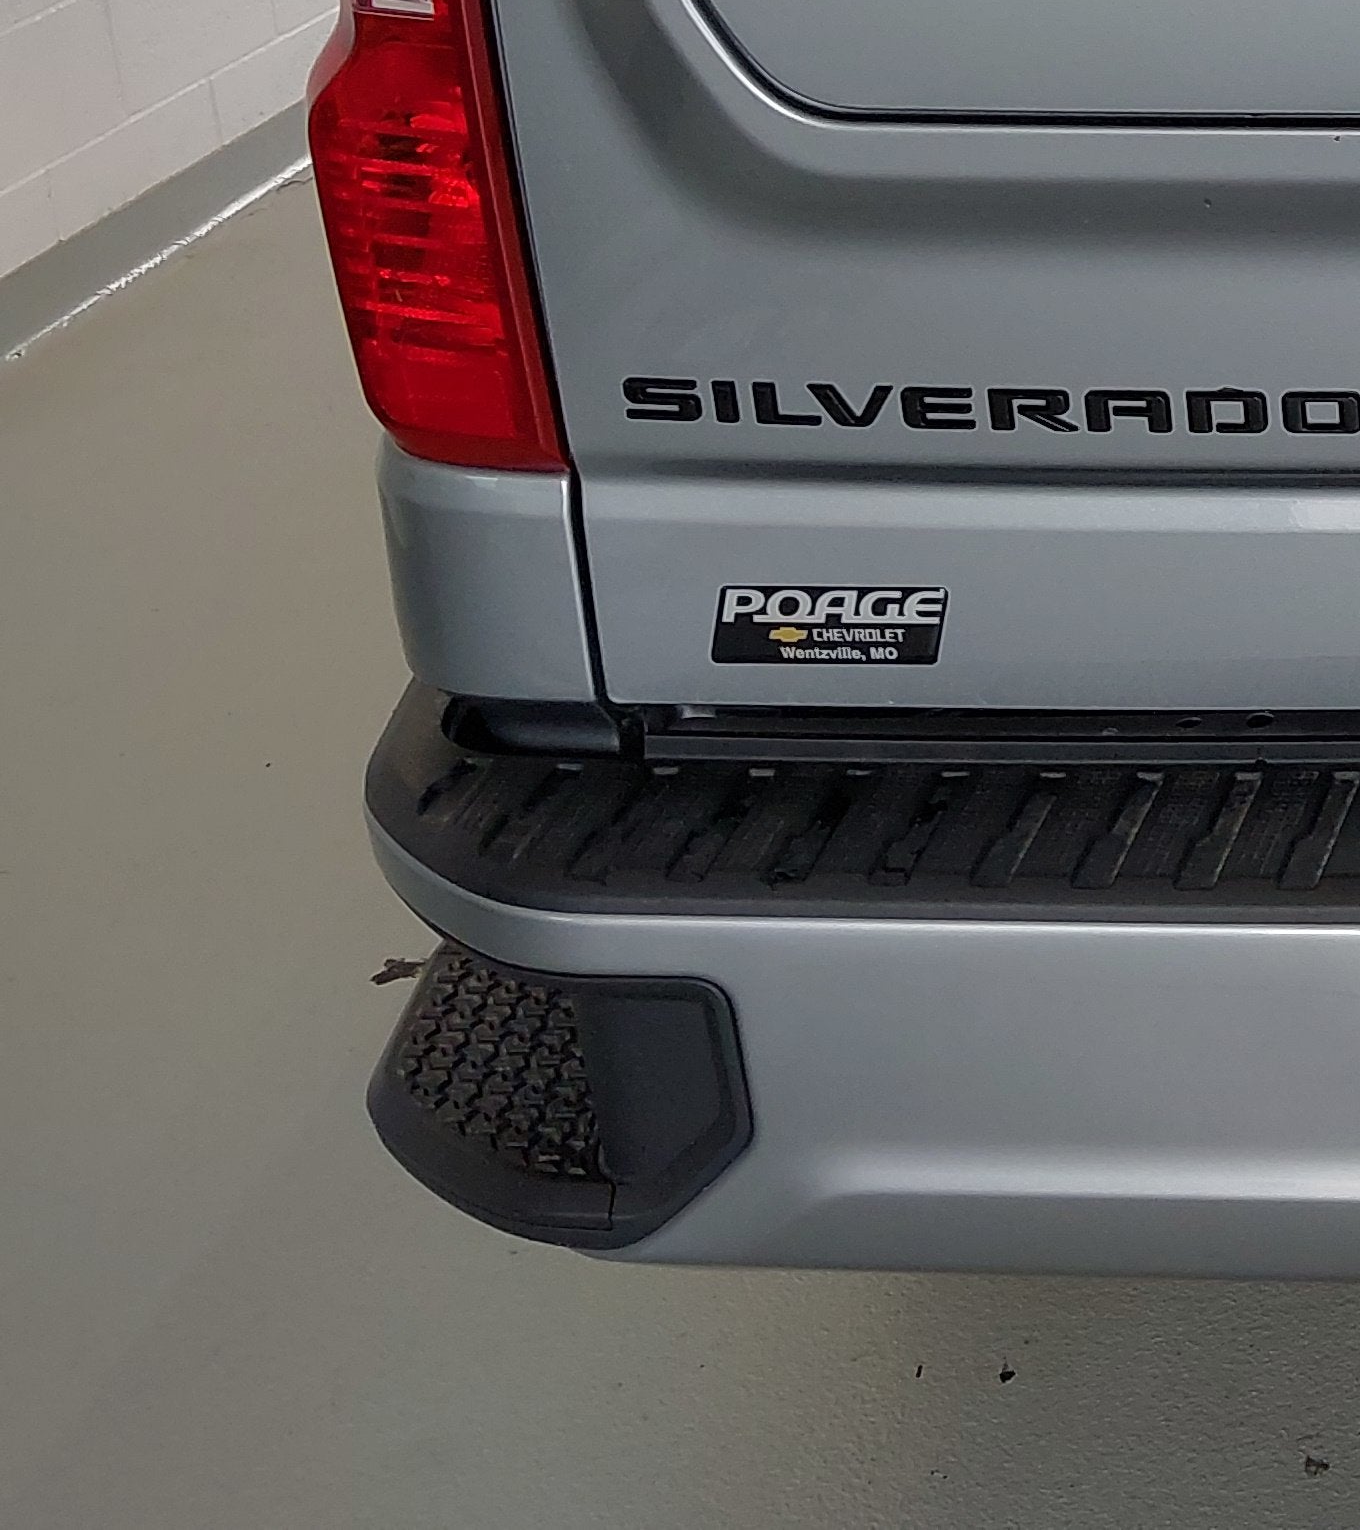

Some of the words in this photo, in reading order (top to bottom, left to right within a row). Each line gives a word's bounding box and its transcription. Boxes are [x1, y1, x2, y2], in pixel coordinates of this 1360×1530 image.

[721, 588, 946, 624] POAGE
[812, 628, 906, 642] CHEVROLET
[780, 646, 867, 661] Wentzville,
[869, 647, 899, 660] MO
